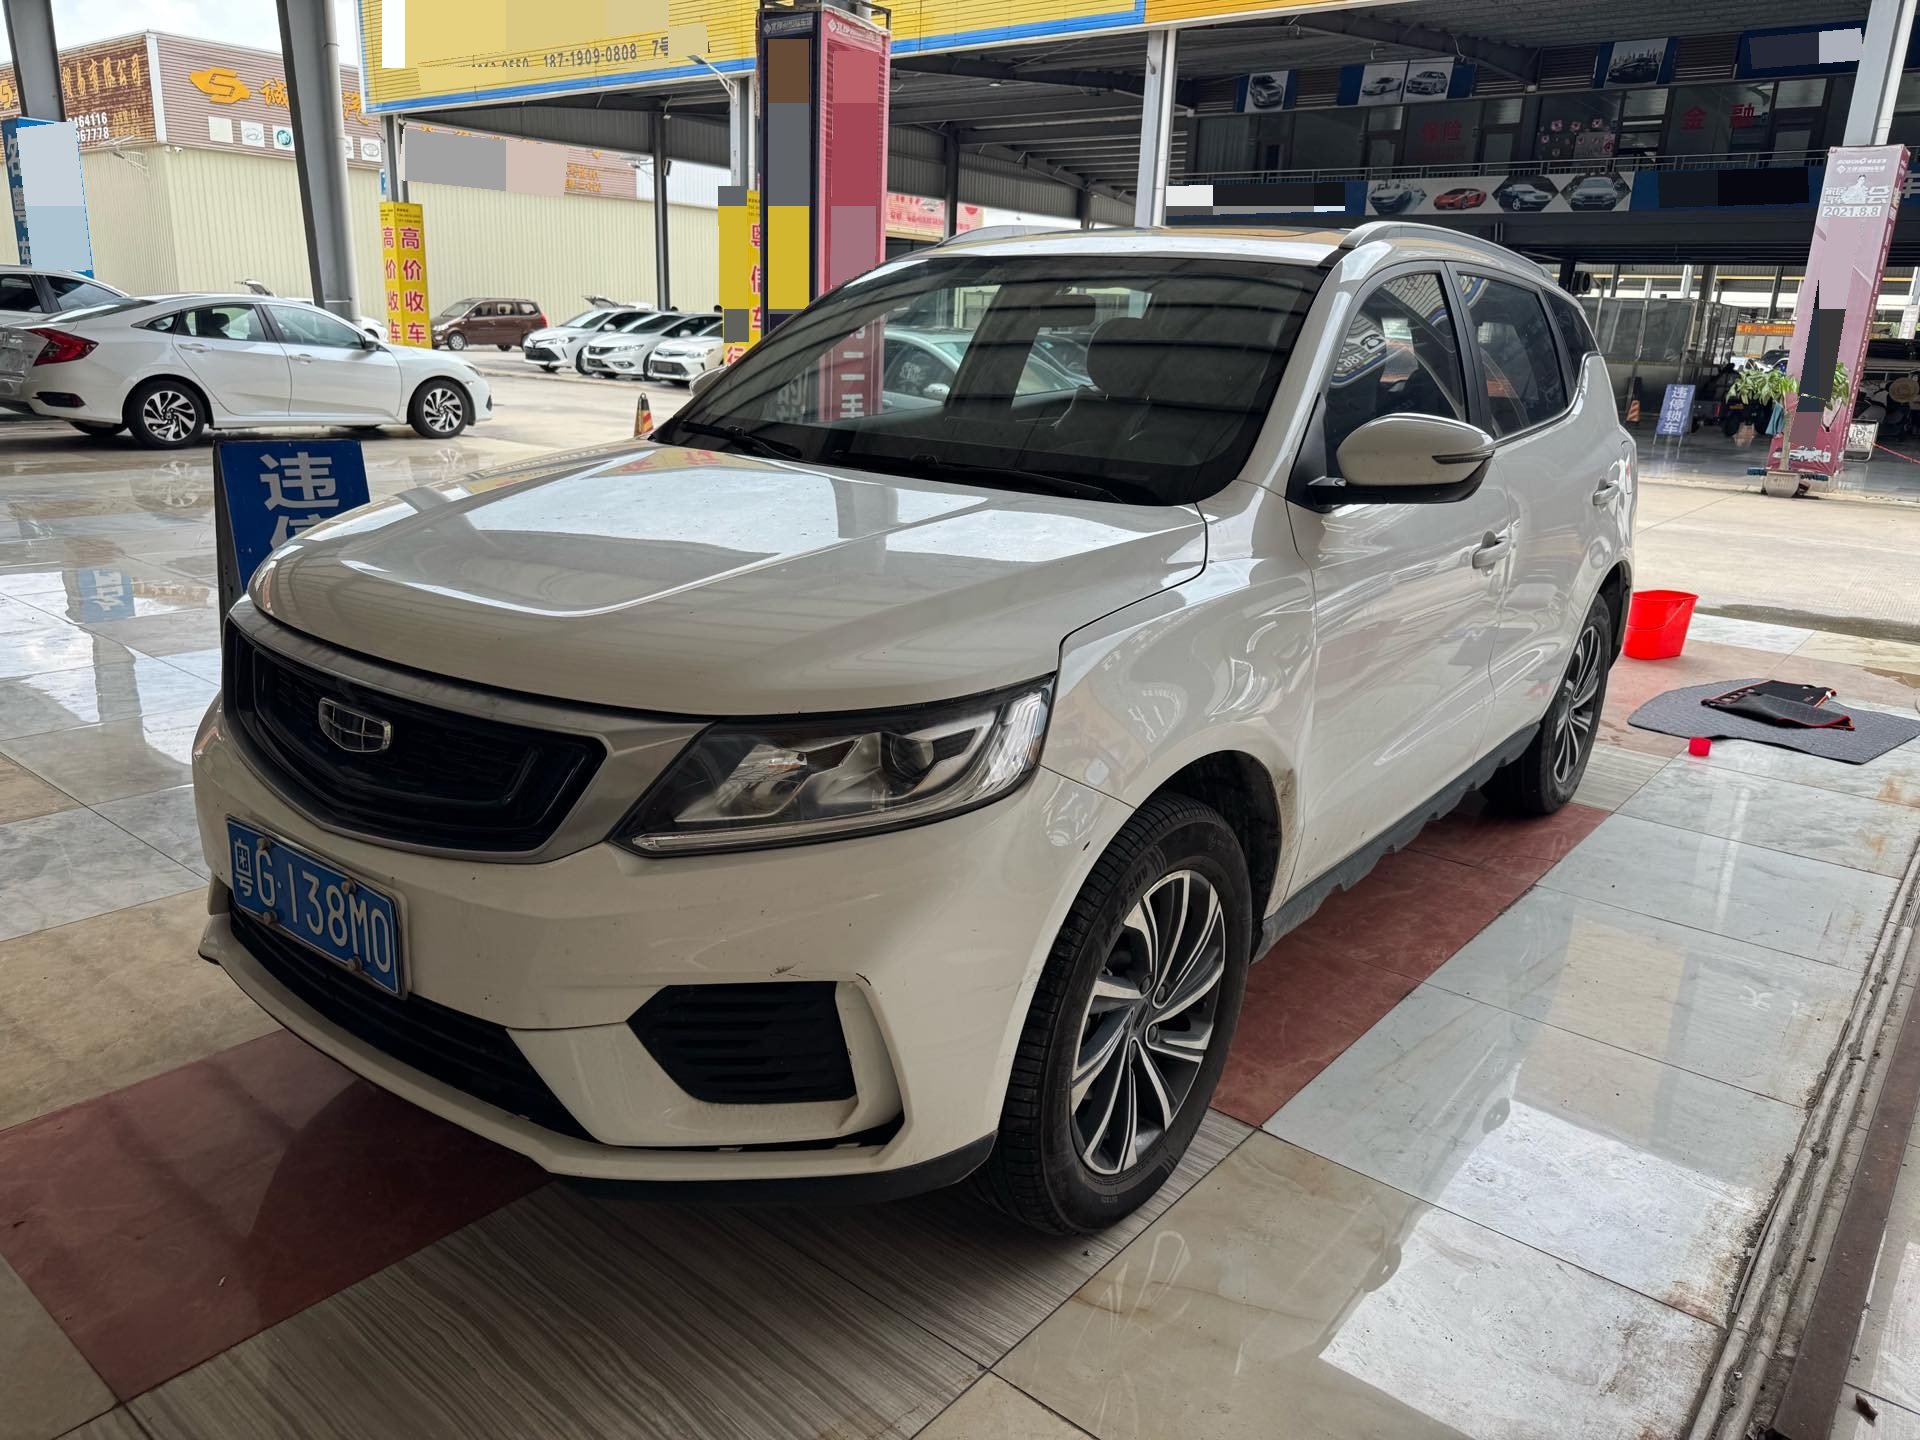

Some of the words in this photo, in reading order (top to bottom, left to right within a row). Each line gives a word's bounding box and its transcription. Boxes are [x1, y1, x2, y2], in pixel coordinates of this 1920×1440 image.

[1823, 207, 1879, 217] 2021.8.8
[399, 227, 427, 343] 高价收车
[1662, 385, 1689, 435] 违停锁车
